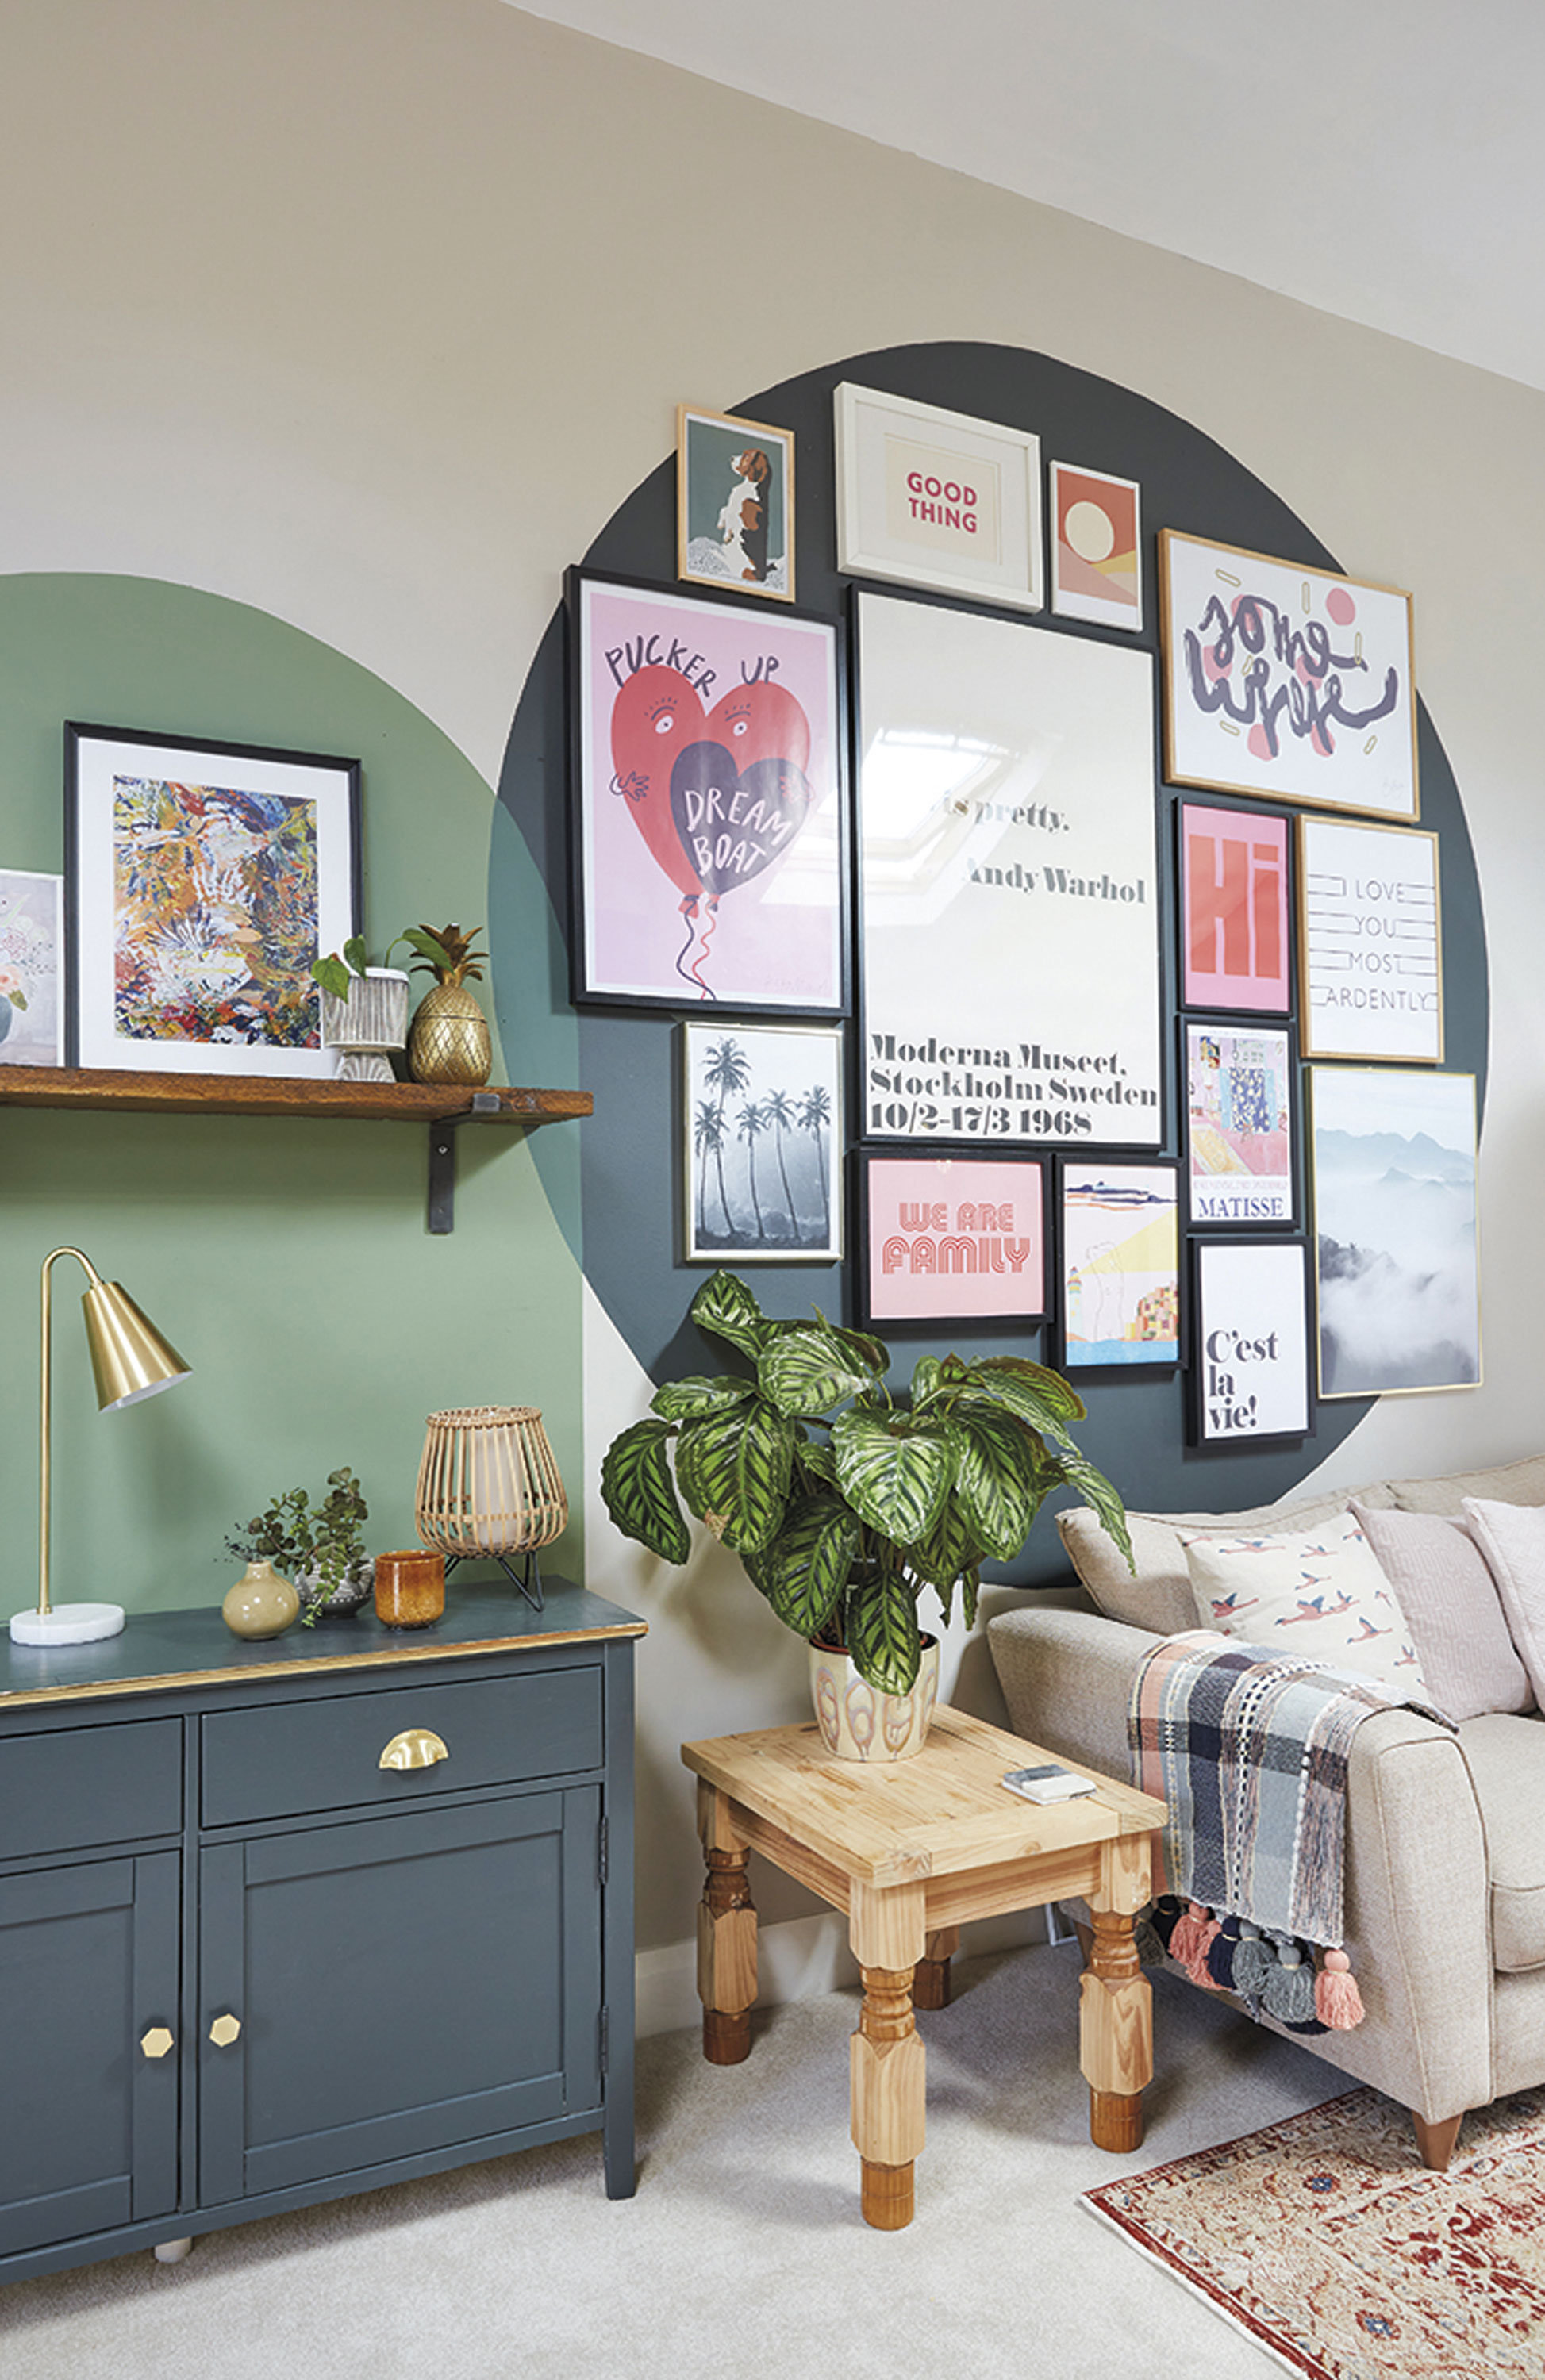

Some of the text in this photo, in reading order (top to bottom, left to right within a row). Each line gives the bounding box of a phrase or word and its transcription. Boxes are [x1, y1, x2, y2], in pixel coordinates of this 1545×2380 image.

[907, 471, 977, 507] GOOD
[909, 497, 977, 534] THING
[605, 635, 780, 697] PUCKER UP
[685, 788, 792, 846] DREAM
[975, 800, 1070, 833] pretty.
[693, 834, 767, 876] BOAT
[962, 858, 1146, 904] Andy Warhol
[1355, 880, 1403, 903] LOVE
[1189, 834, 1281, 979] Hi
[1353, 916, 1395, 938] YOU
[1348, 952, 1406, 973] MOST
[1326, 988, 1428, 1011] ARDENTLY
[871, 1034, 1011, 1069] Moderna
[870, 1066, 1158, 1107] Stockholm Sweden
[871, 1101, 1093, 1136] 10/2-17/3 1968
[898, 1203, 1014, 1232] WE ARE
[1198, 1196, 1284, 1218] MATISSE
[882, 1235, 1031, 1274] FAMILY
[1209, 1365, 1236, 1397] la
[1209, 1394, 1258, 1430] vie!
